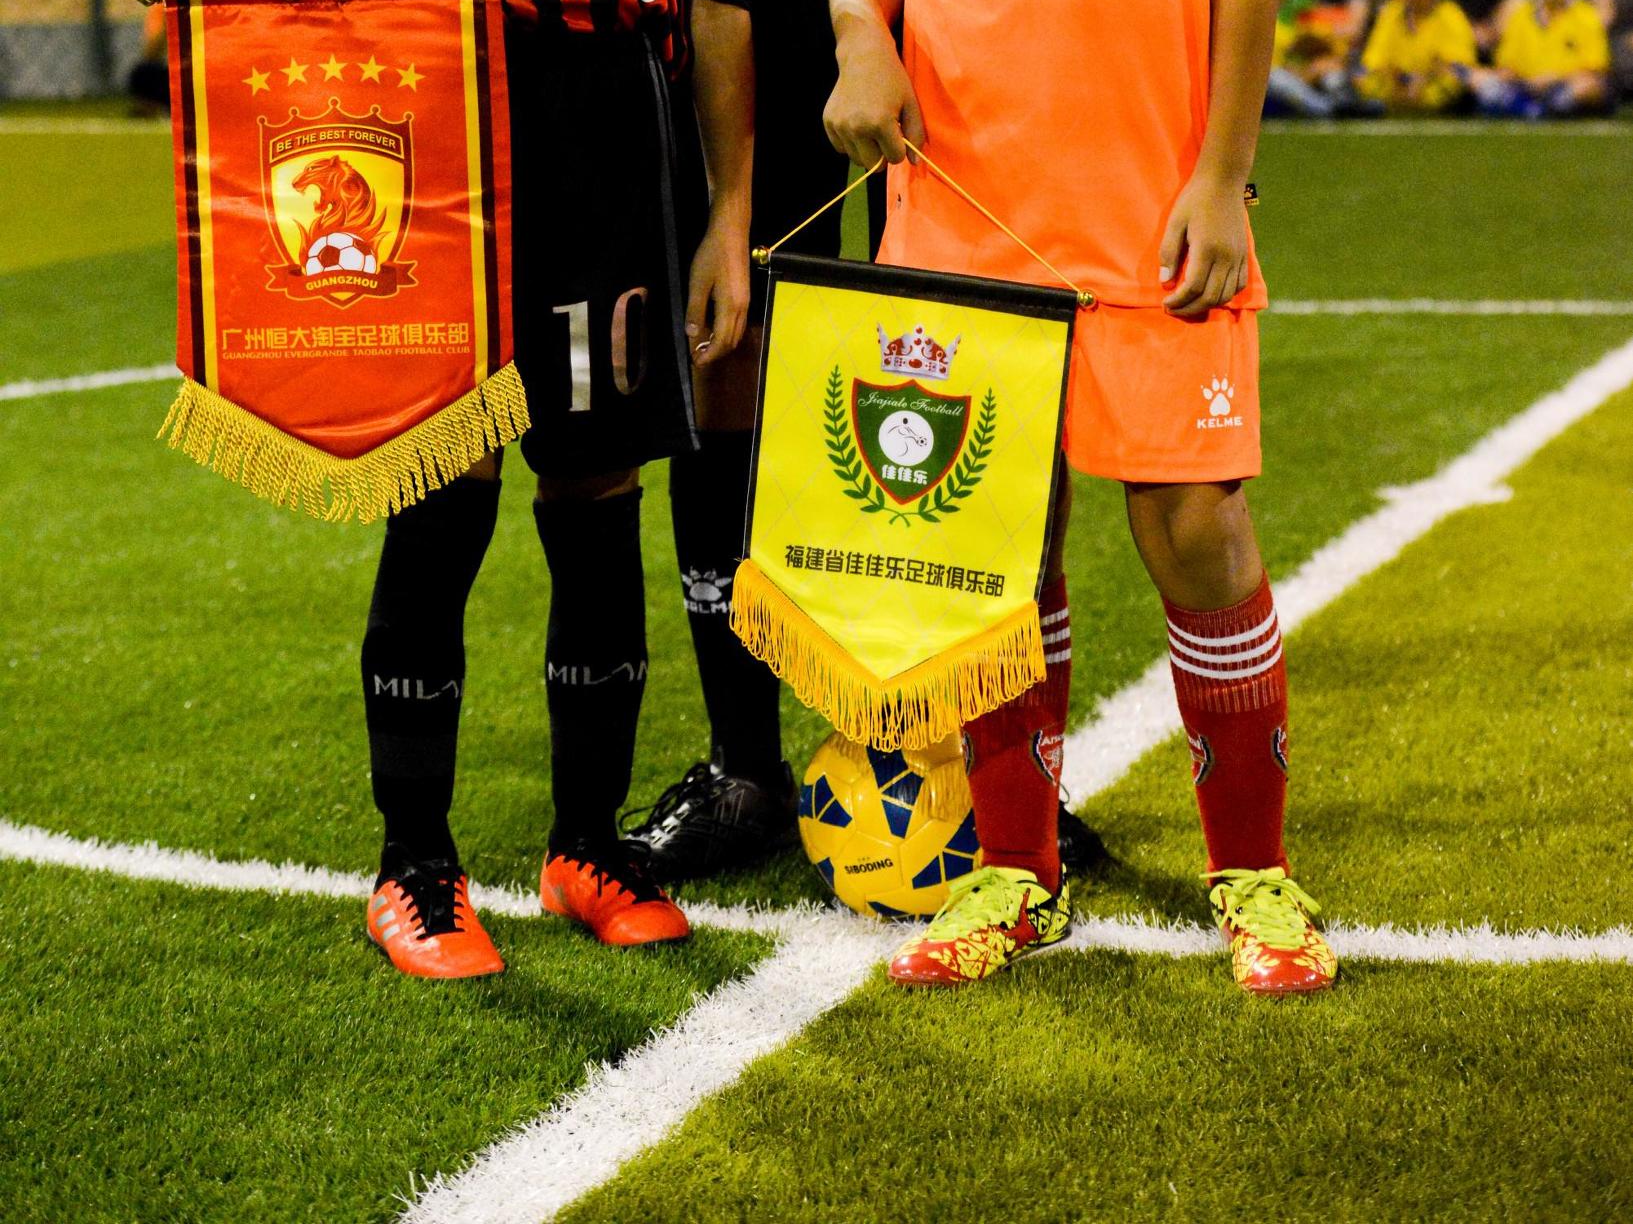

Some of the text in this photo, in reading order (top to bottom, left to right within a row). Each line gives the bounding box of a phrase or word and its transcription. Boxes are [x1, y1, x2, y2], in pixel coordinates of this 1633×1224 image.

[276, 129, 397, 153] BE THE BEST FOREVER
[305, 275, 378, 291] GUANGZHOU
[222, 322, 470, 350] 广州恒大淘宝足球俱乐部
[222, 345, 471, 360] GUANGZHOU EVERGRANDE TAOBAO FOOTBALL CLUB
[552, 286, 648, 412] 10
[910, 397, 964, 417] Football
[1196, 416, 1244, 429] KELME
[881, 464, 928, 485] 佳佳乐
[784, 544, 1006, 598] 福建省佳佳乐足球俱乐部
[373, 673, 465, 700] MILA
